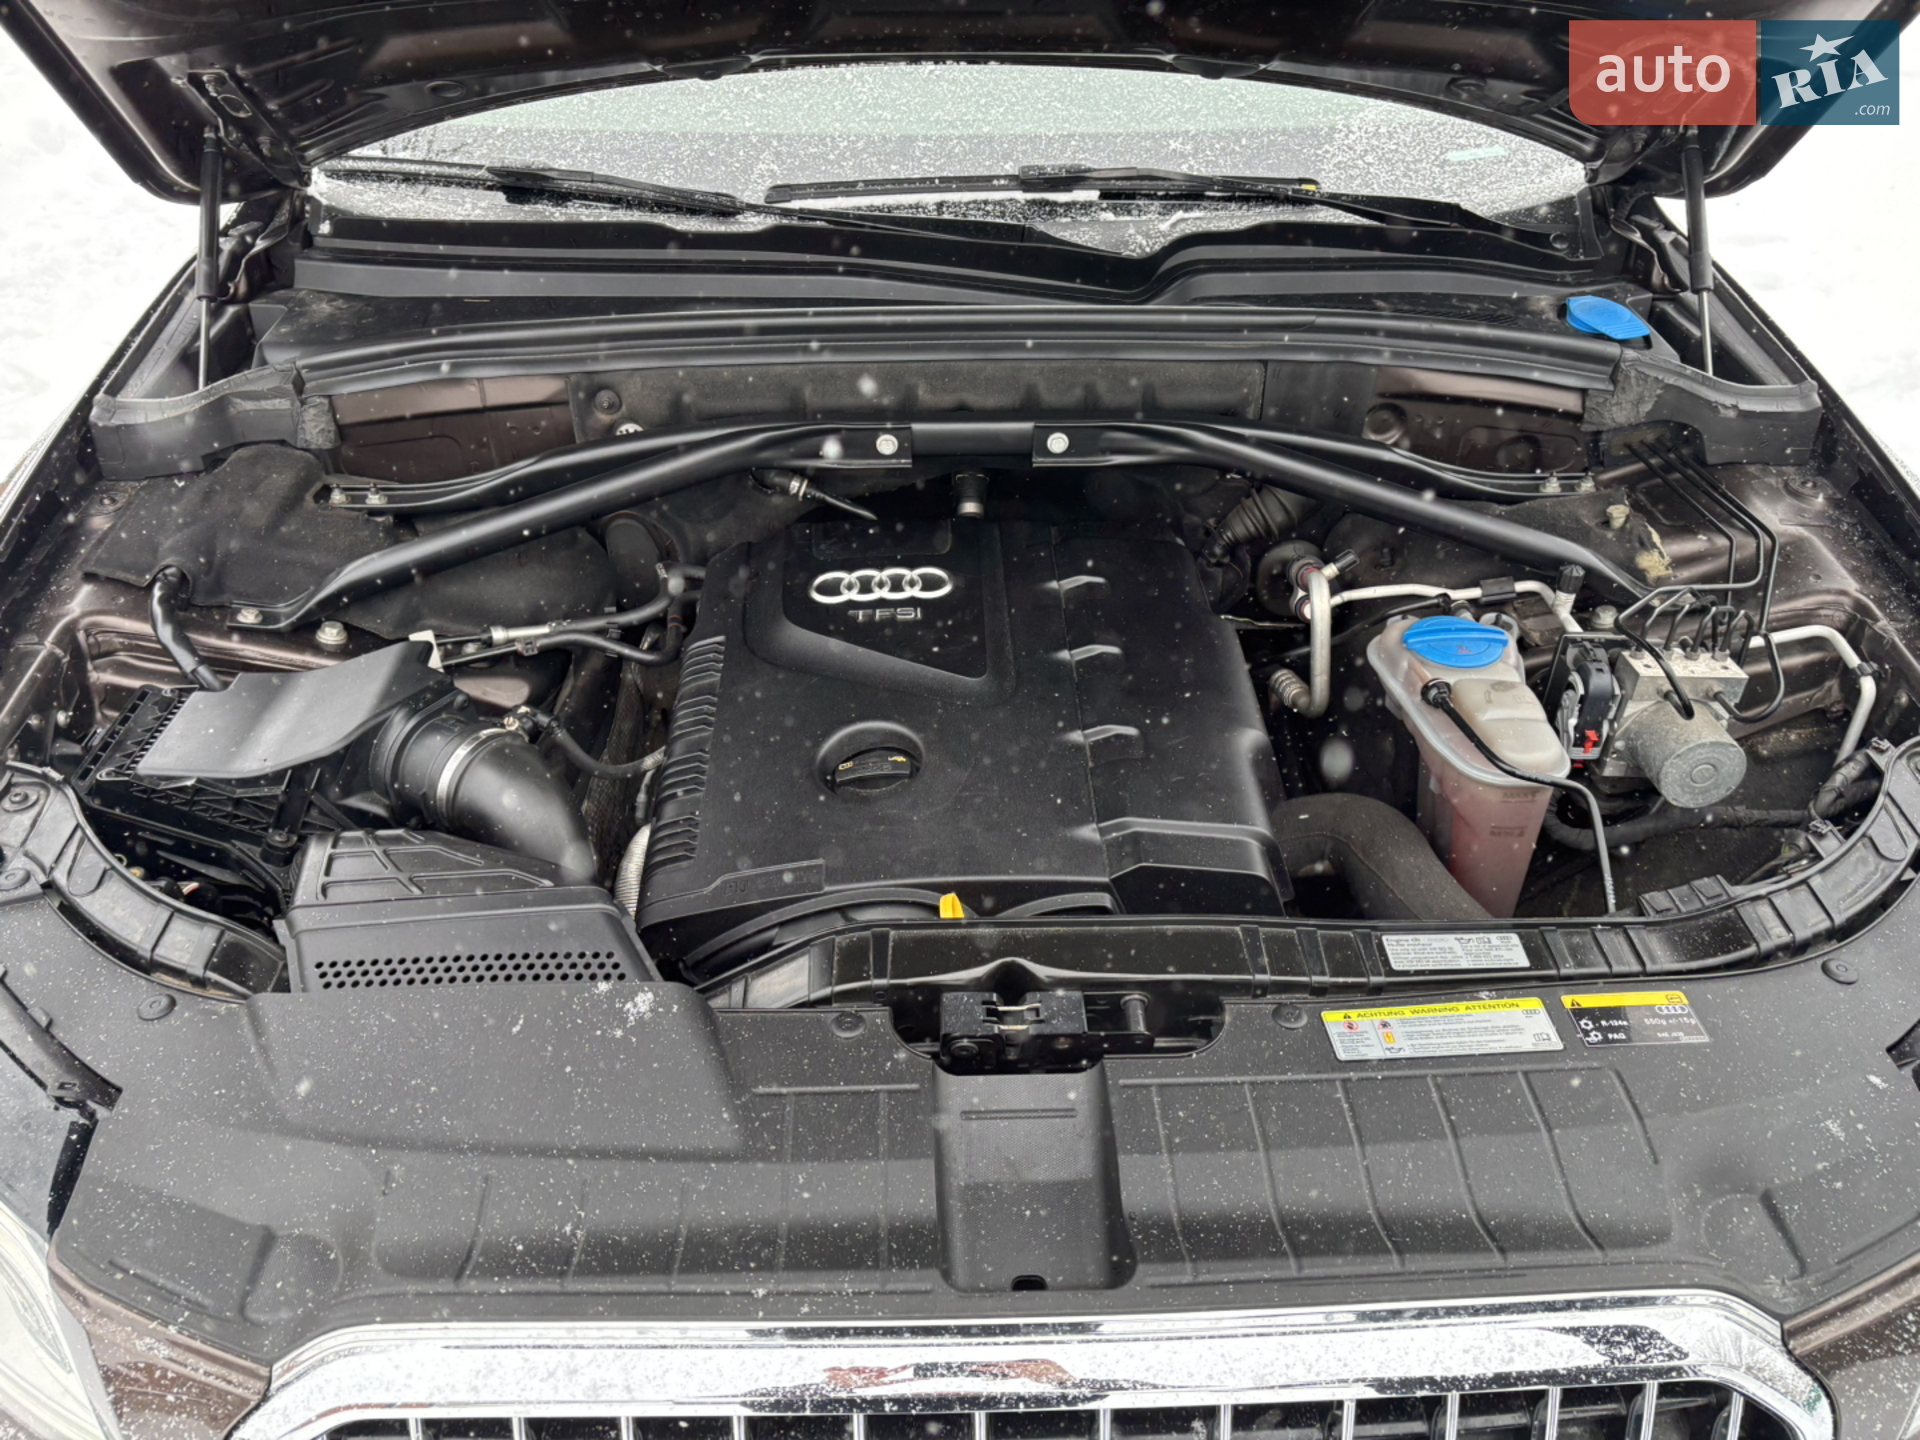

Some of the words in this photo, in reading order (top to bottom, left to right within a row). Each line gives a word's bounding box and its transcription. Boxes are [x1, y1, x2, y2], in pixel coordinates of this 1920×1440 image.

[847, 607, 922, 622] TFSI
[1356, 1010, 1405, 1019] ACHTUNG
[1410, 1006, 1460, 1015] WARNING
[1465, 1002, 1520, 1011] ATTENTION
